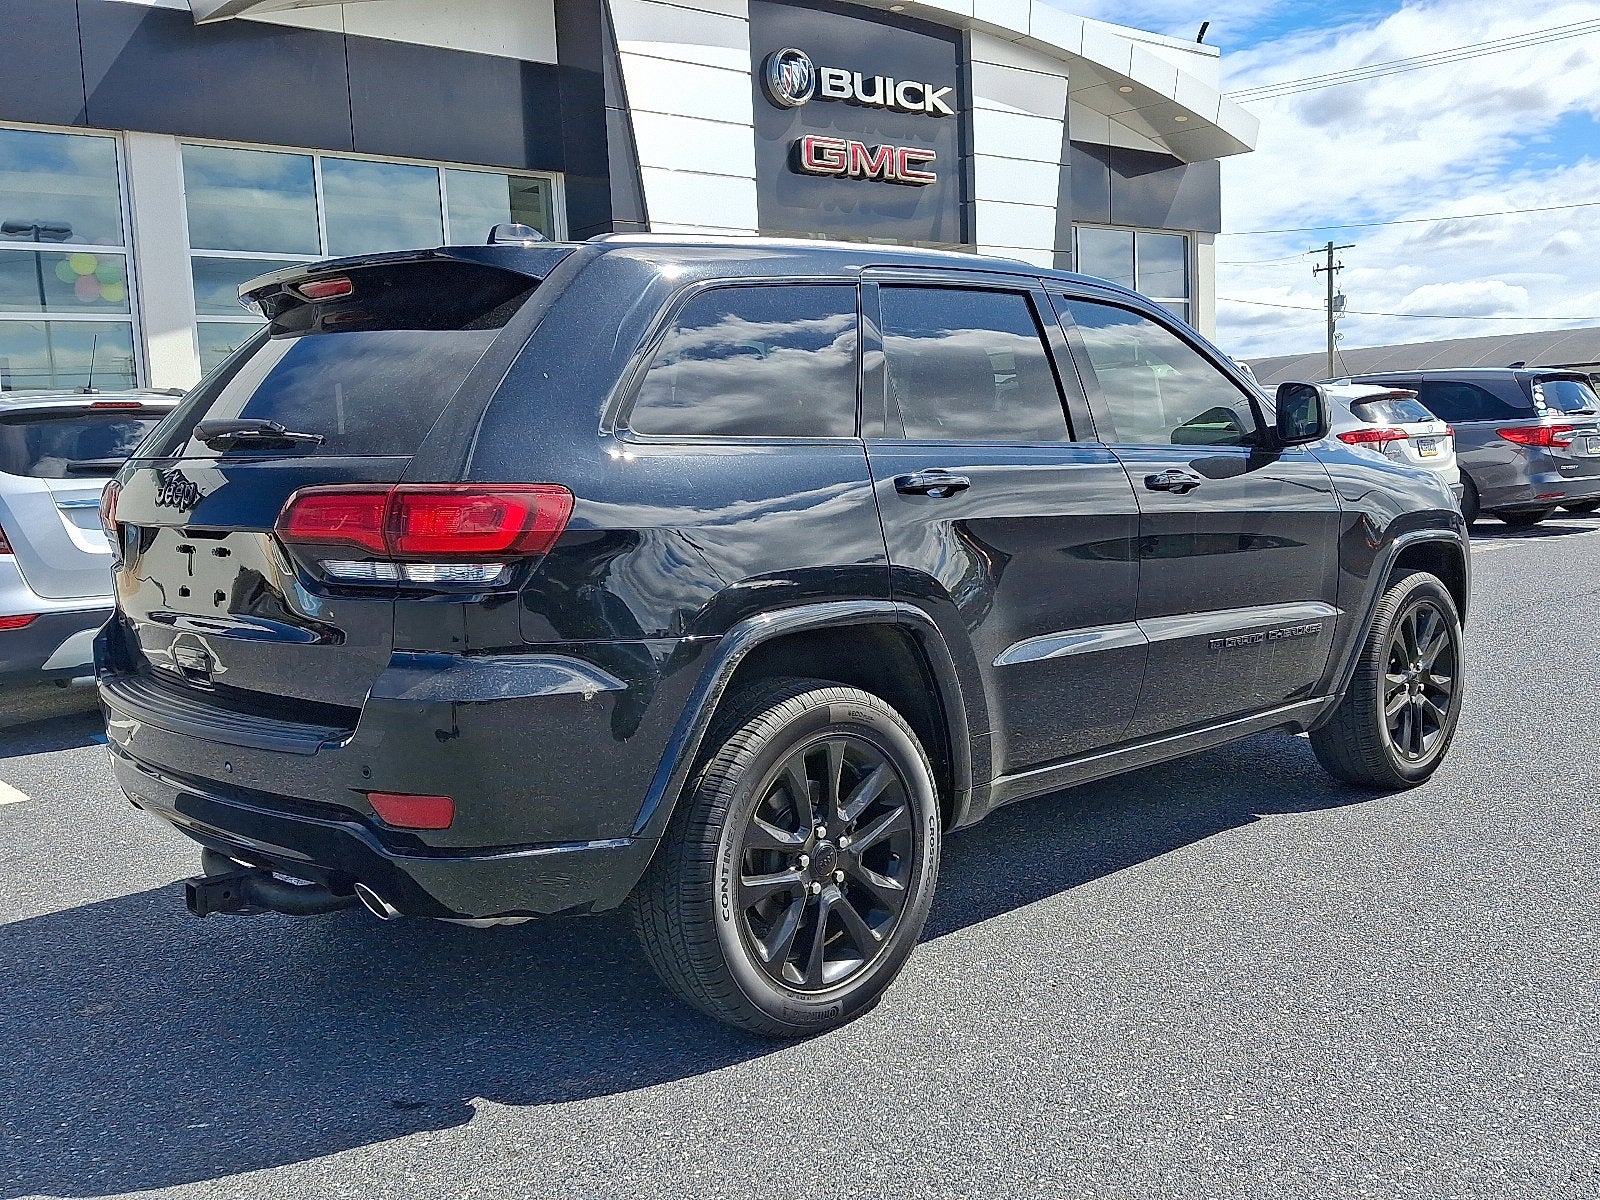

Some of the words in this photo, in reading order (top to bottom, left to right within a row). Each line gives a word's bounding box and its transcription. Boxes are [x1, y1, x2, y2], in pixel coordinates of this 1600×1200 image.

[820, 66, 955, 115] BUICK
[801, 134, 937, 185] GMC
[154, 473, 198, 513] Jeep
[1225, 632, 1266, 648] GRAND
